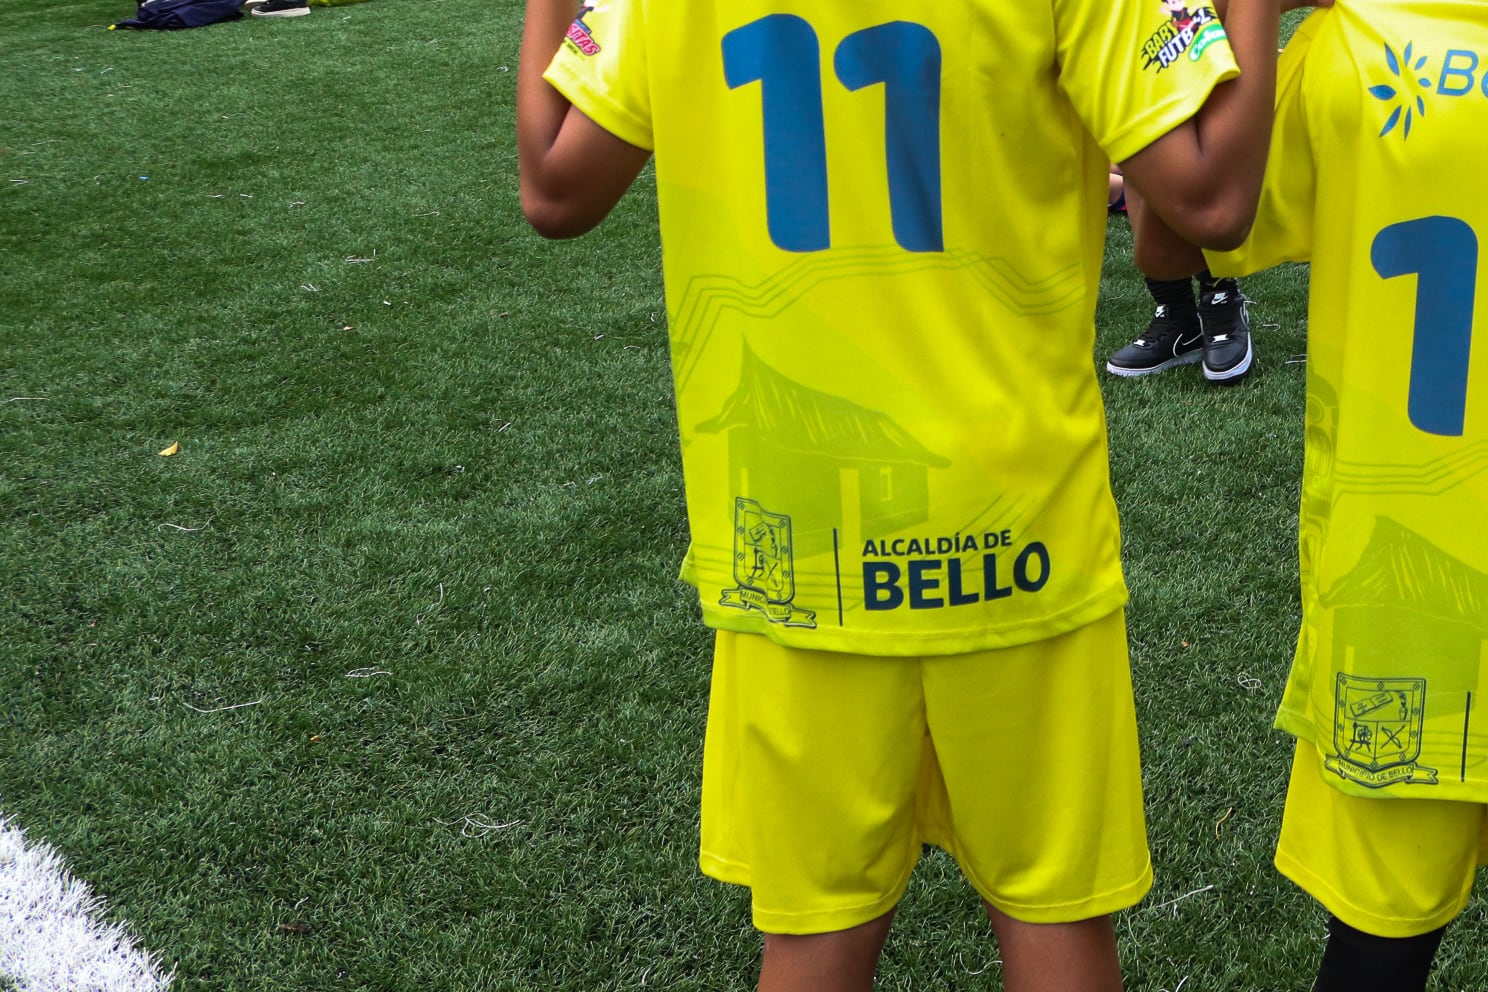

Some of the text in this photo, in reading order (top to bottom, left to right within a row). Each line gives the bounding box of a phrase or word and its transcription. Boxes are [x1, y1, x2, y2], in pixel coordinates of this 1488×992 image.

[721, 13, 944, 253] 11
[862, 529, 1012, 557] ALCALDÍA DE
[862, 541, 1051, 611] BELLO
[1388, 766, 1413, 778] BELLO
